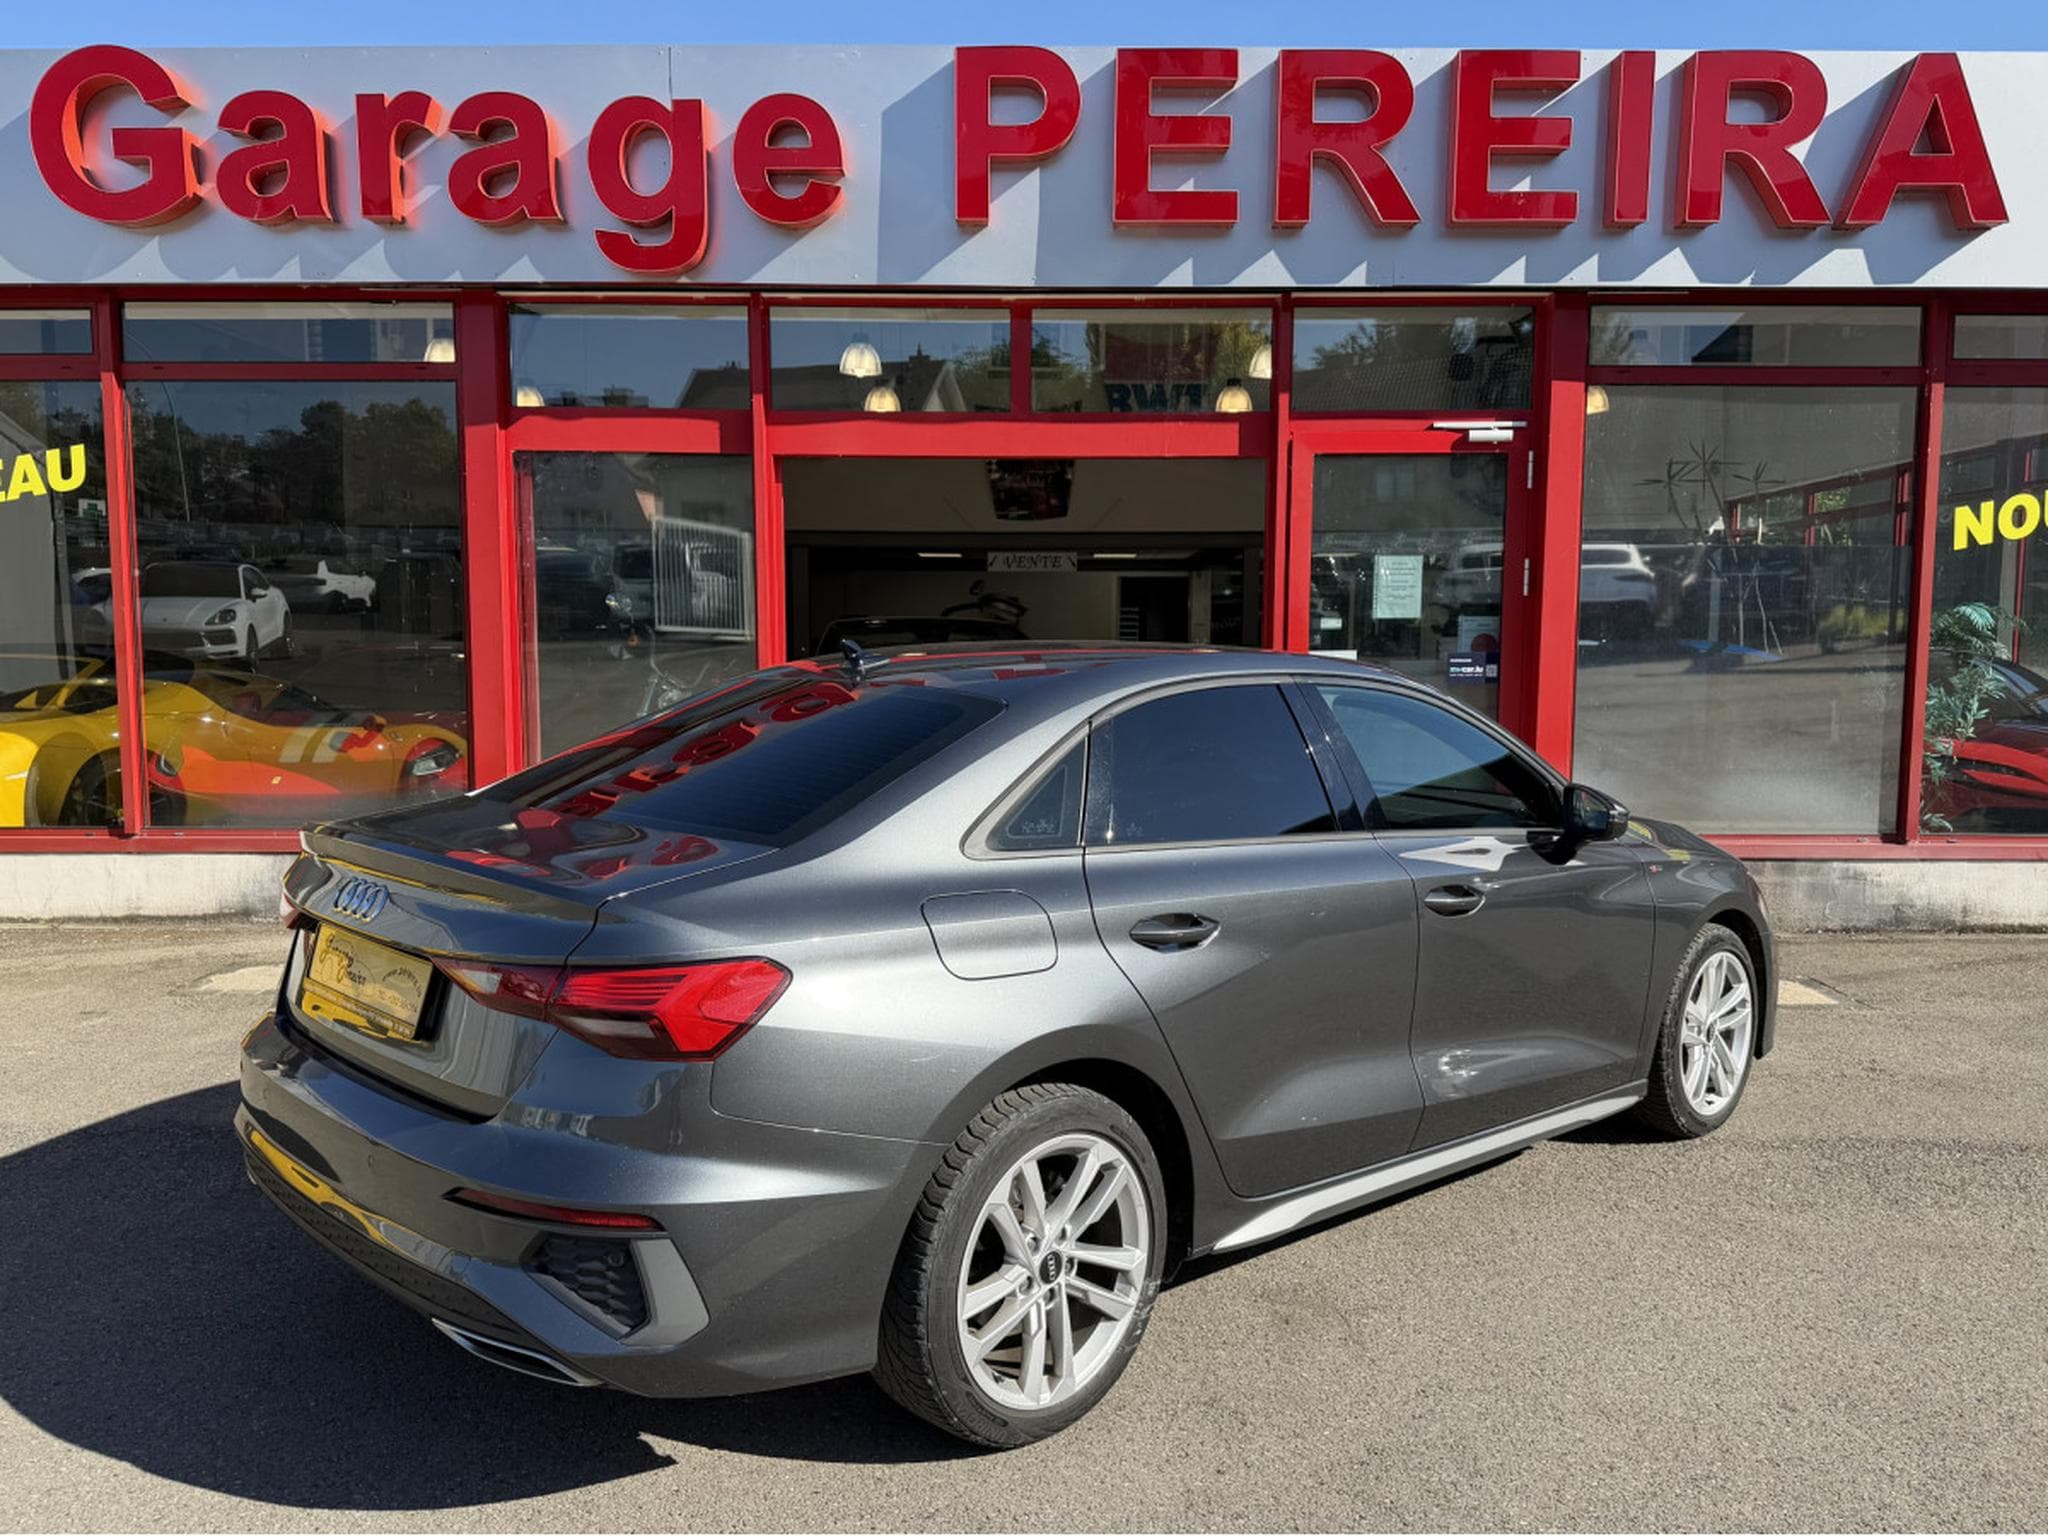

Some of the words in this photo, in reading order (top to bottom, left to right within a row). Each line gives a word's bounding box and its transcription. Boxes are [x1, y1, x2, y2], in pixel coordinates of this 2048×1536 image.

[30, 44, 846, 274] Garage
[954, 46, 2009, 230] PEREIRA
[1953, 489, 2048, 551] NO
[1003, 554, 1063, 569] VENTE
